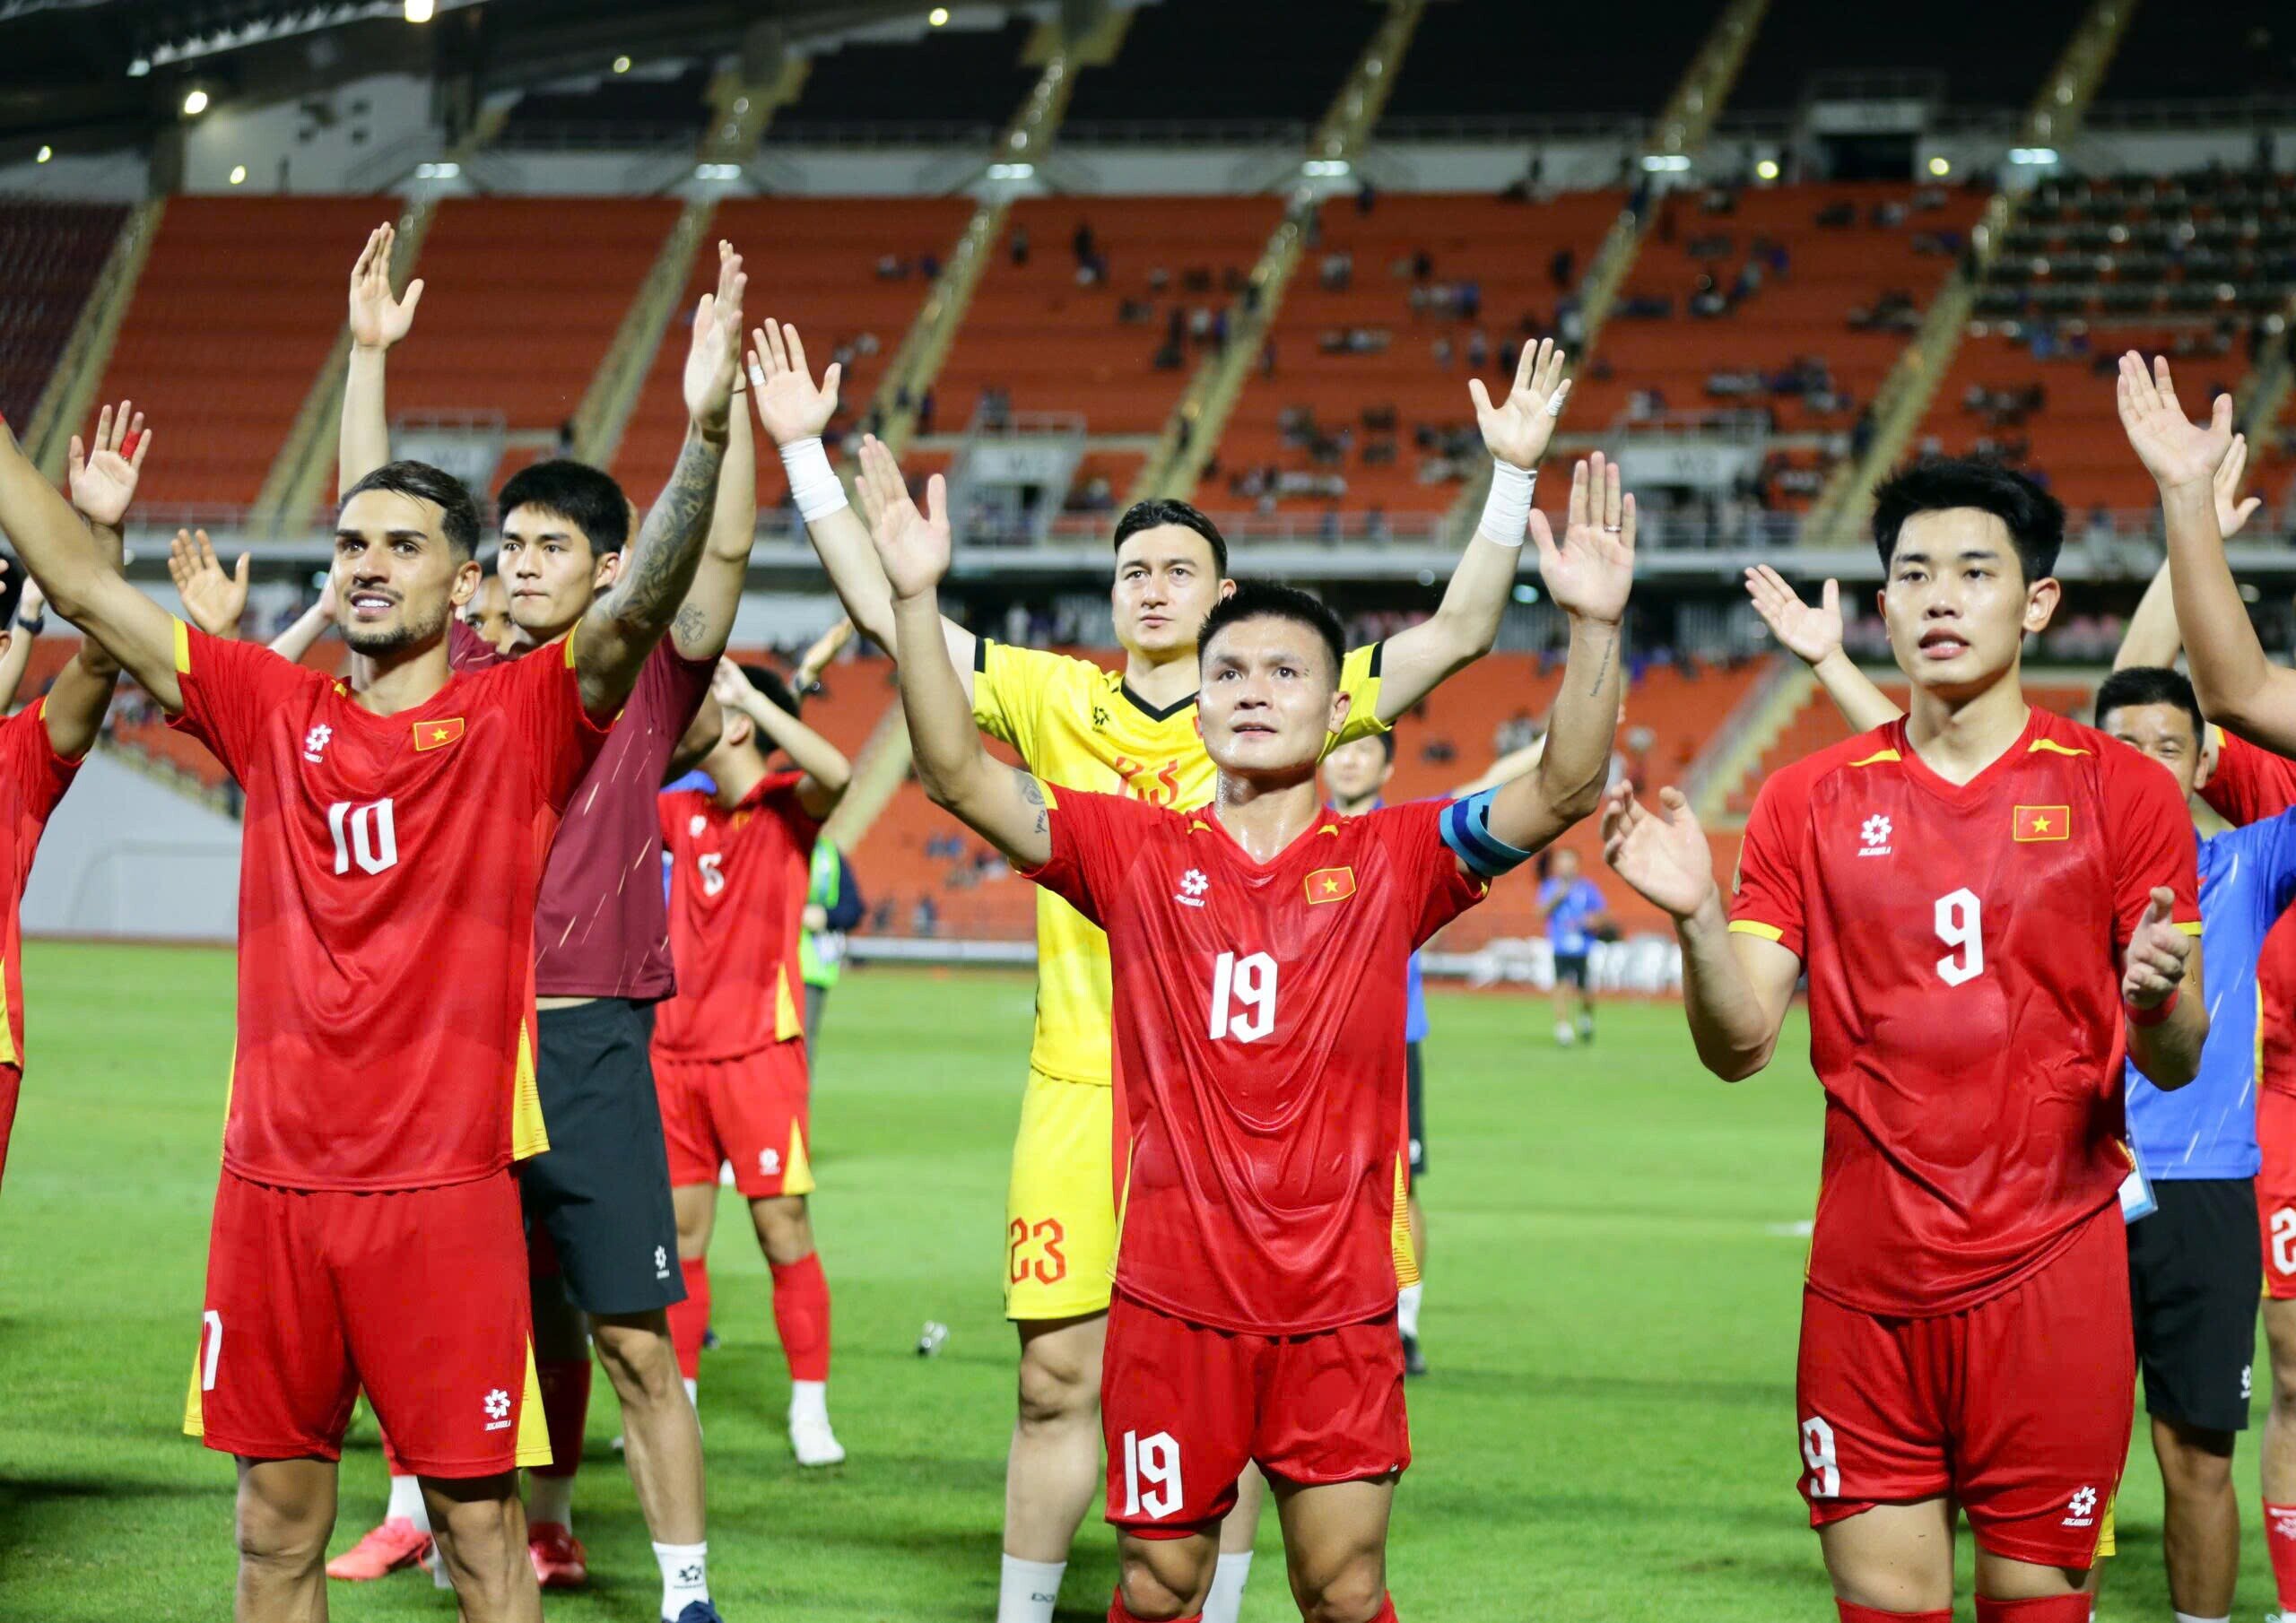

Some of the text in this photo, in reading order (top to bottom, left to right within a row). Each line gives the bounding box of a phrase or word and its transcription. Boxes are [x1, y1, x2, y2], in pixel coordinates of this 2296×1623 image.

[328, 797, 398, 876] 10
[1935, 887, 1984, 988] 9
[1209, 950, 1278, 1044] 19
[1010, 1217, 1065, 1285] 23
[1123, 1429, 1184, 1520] 19
[1802, 1416, 1840, 1497] 9
